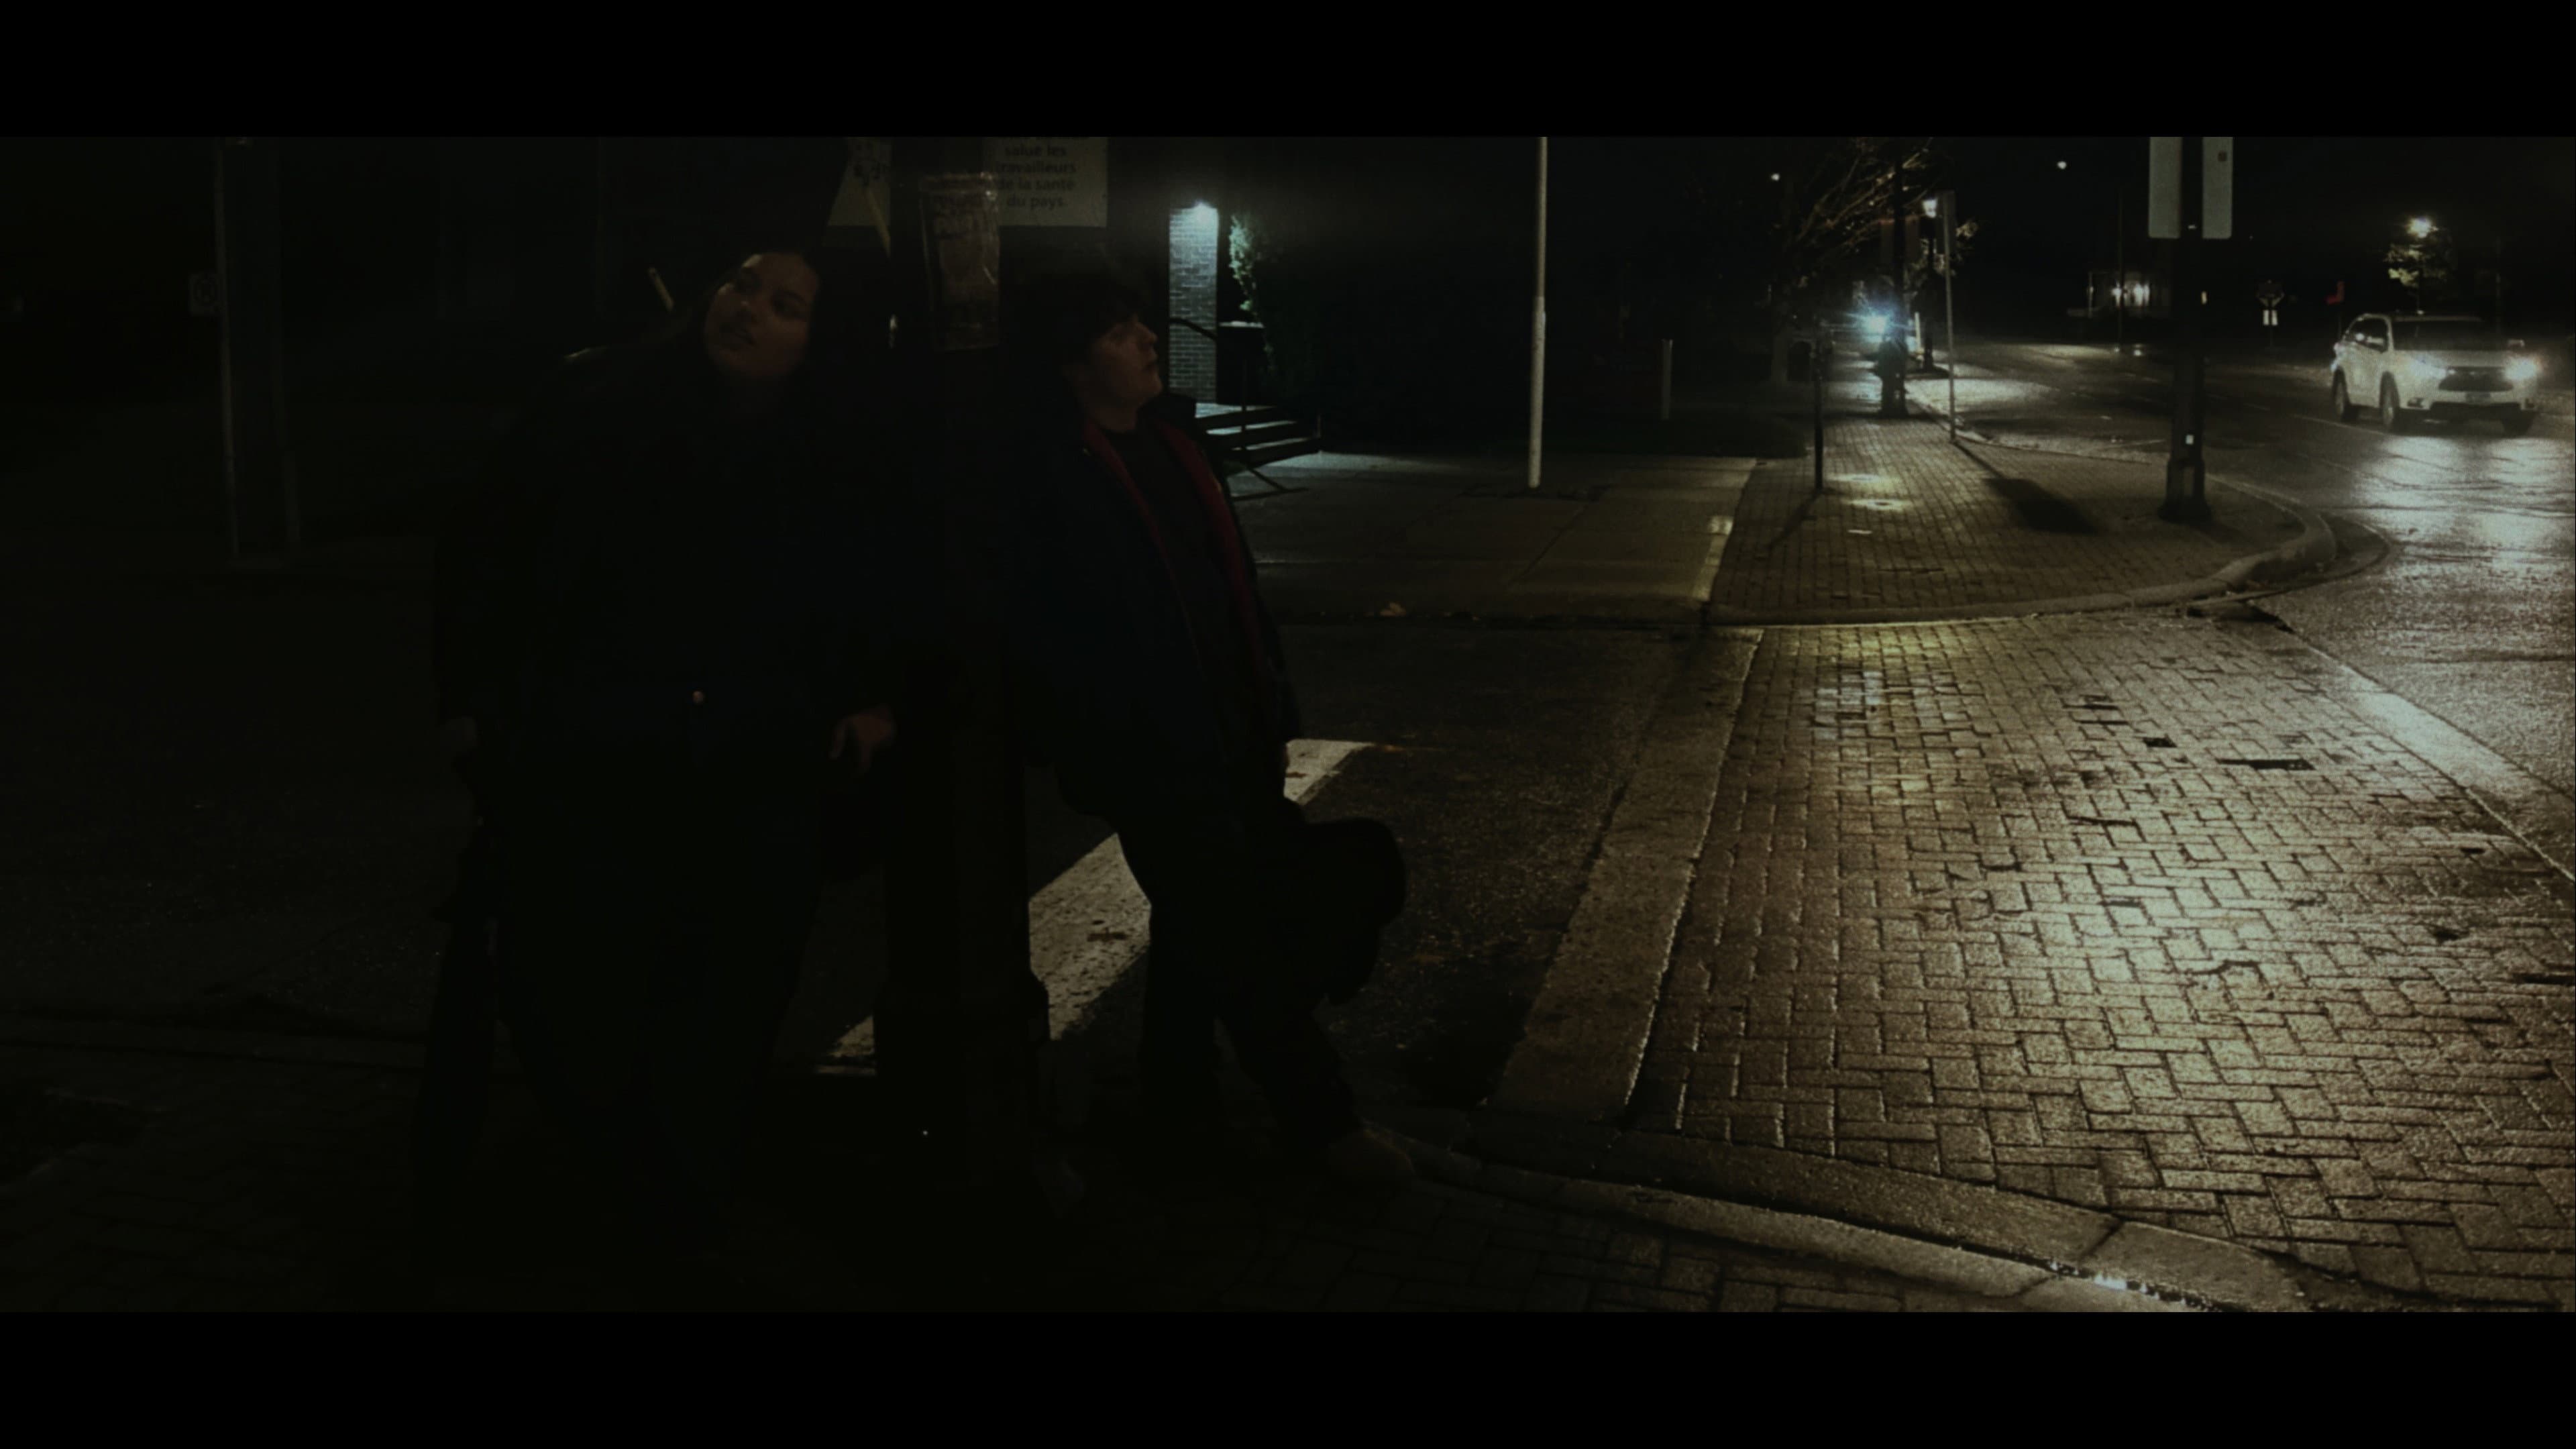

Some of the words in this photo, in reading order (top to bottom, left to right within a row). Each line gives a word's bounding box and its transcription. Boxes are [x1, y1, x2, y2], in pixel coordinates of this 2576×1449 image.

[1046, 144, 1067, 156] les
[998, 178, 1014, 191] de
[1018, 177, 1032, 190] la
[1006, 193, 1026, 207] du
